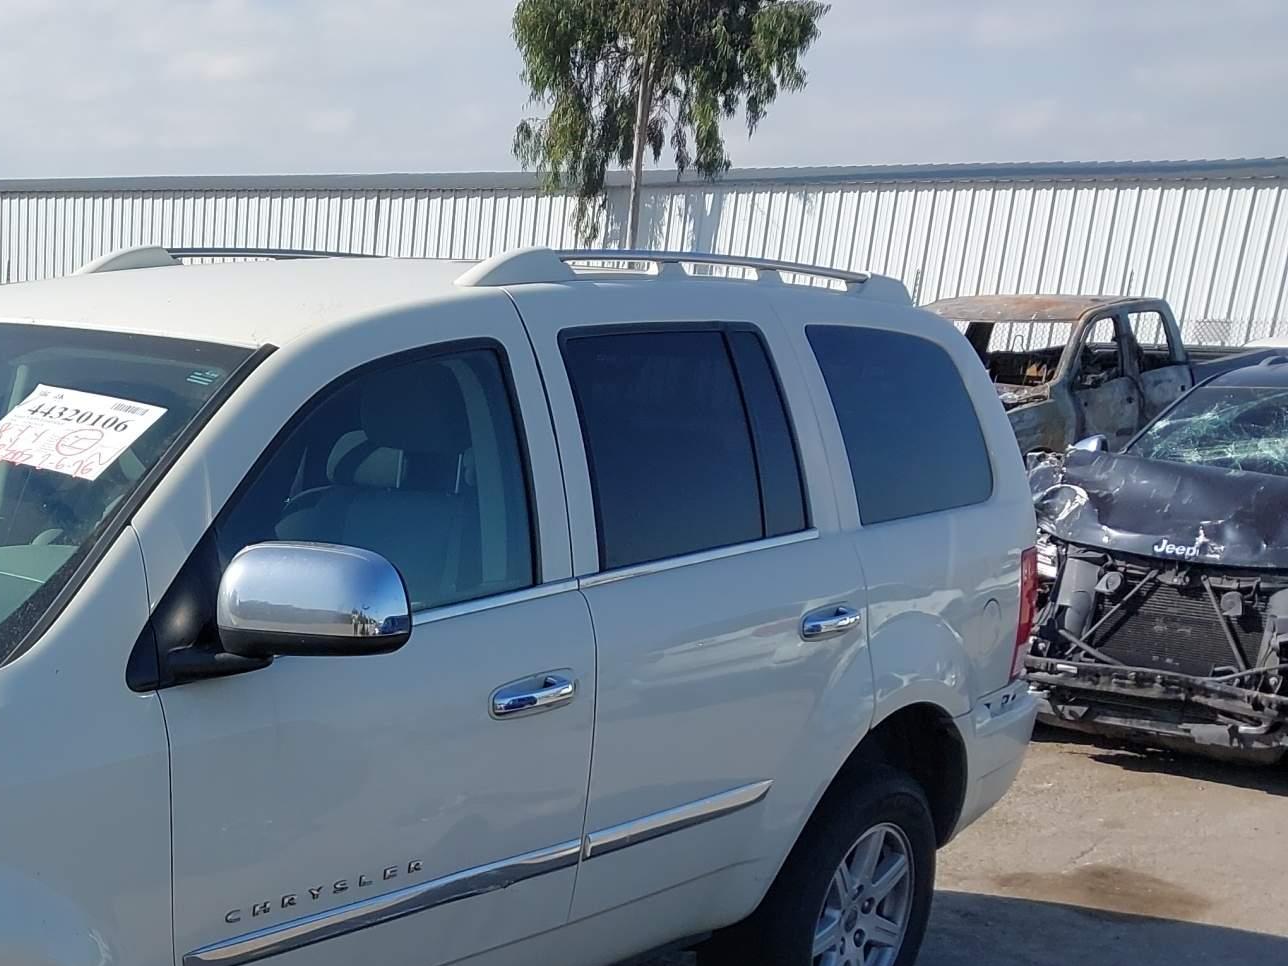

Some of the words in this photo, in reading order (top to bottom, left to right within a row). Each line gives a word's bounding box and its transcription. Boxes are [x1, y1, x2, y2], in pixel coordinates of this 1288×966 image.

[27, 402, 136, 433] 44320106
[1153, 538, 1198, 561] Jeep
[224, 859, 424, 924] CHRYSLER
